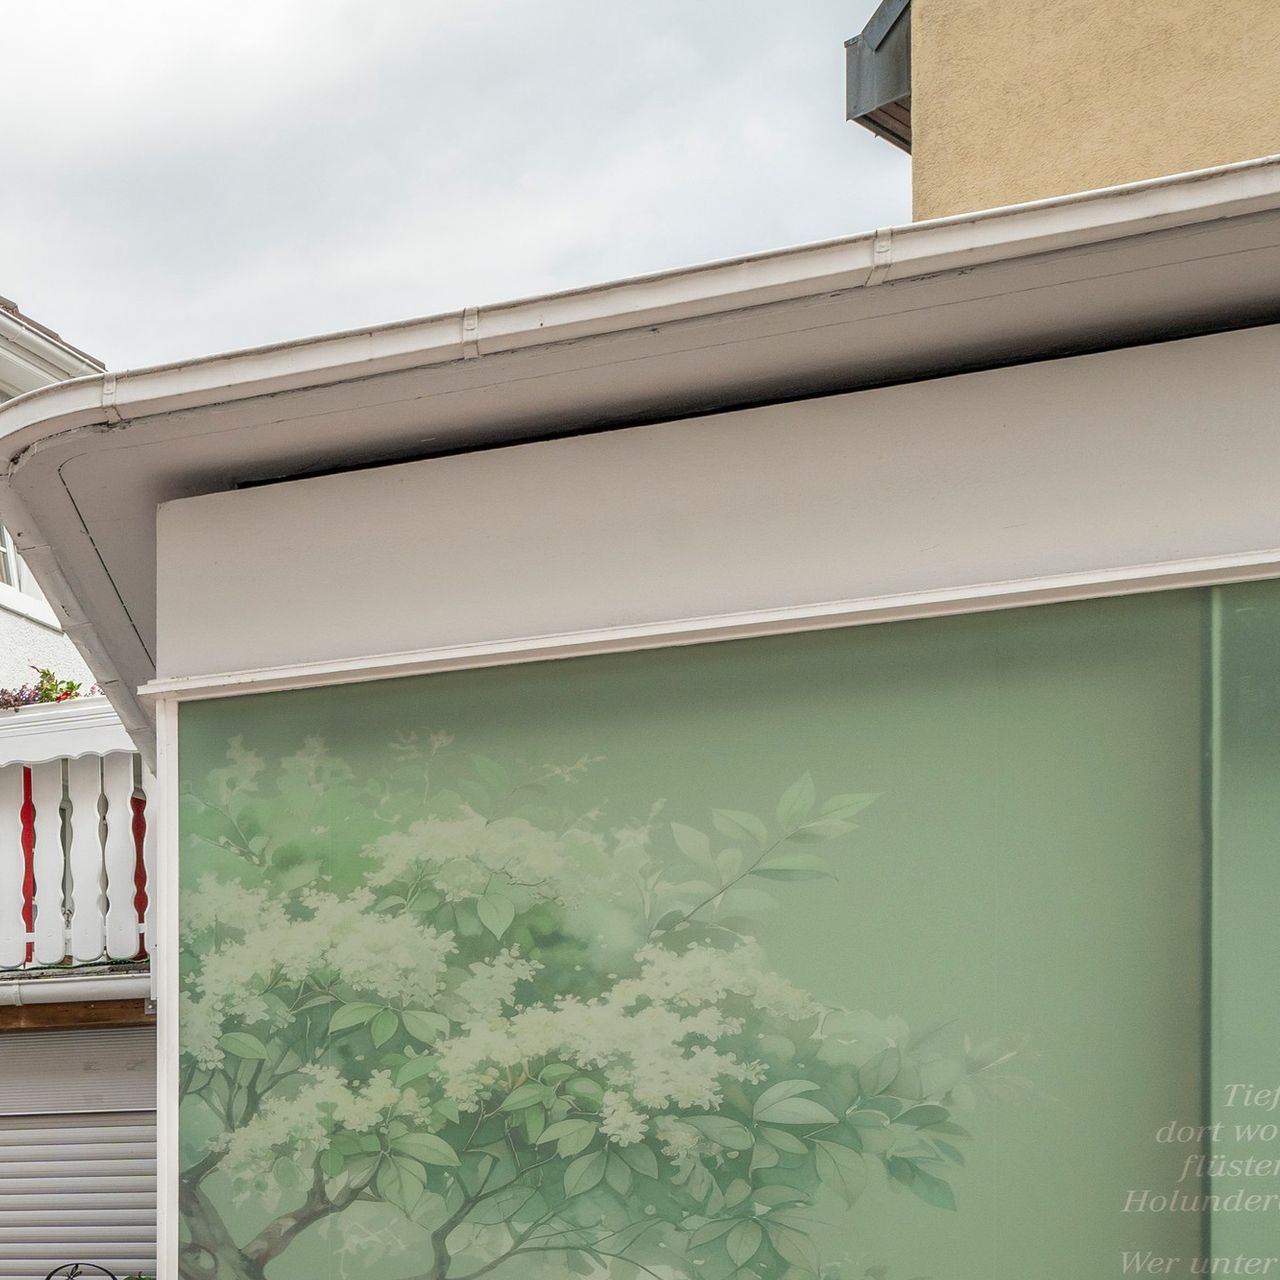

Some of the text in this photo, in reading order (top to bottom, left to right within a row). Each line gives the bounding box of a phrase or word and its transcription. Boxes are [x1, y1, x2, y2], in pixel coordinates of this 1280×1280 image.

[1156, 1120, 1278, 1143] dort wo
[1121, 1189, 1280, 1213] Holunder
[1121, 1251, 1278, 1274] Wer unter
